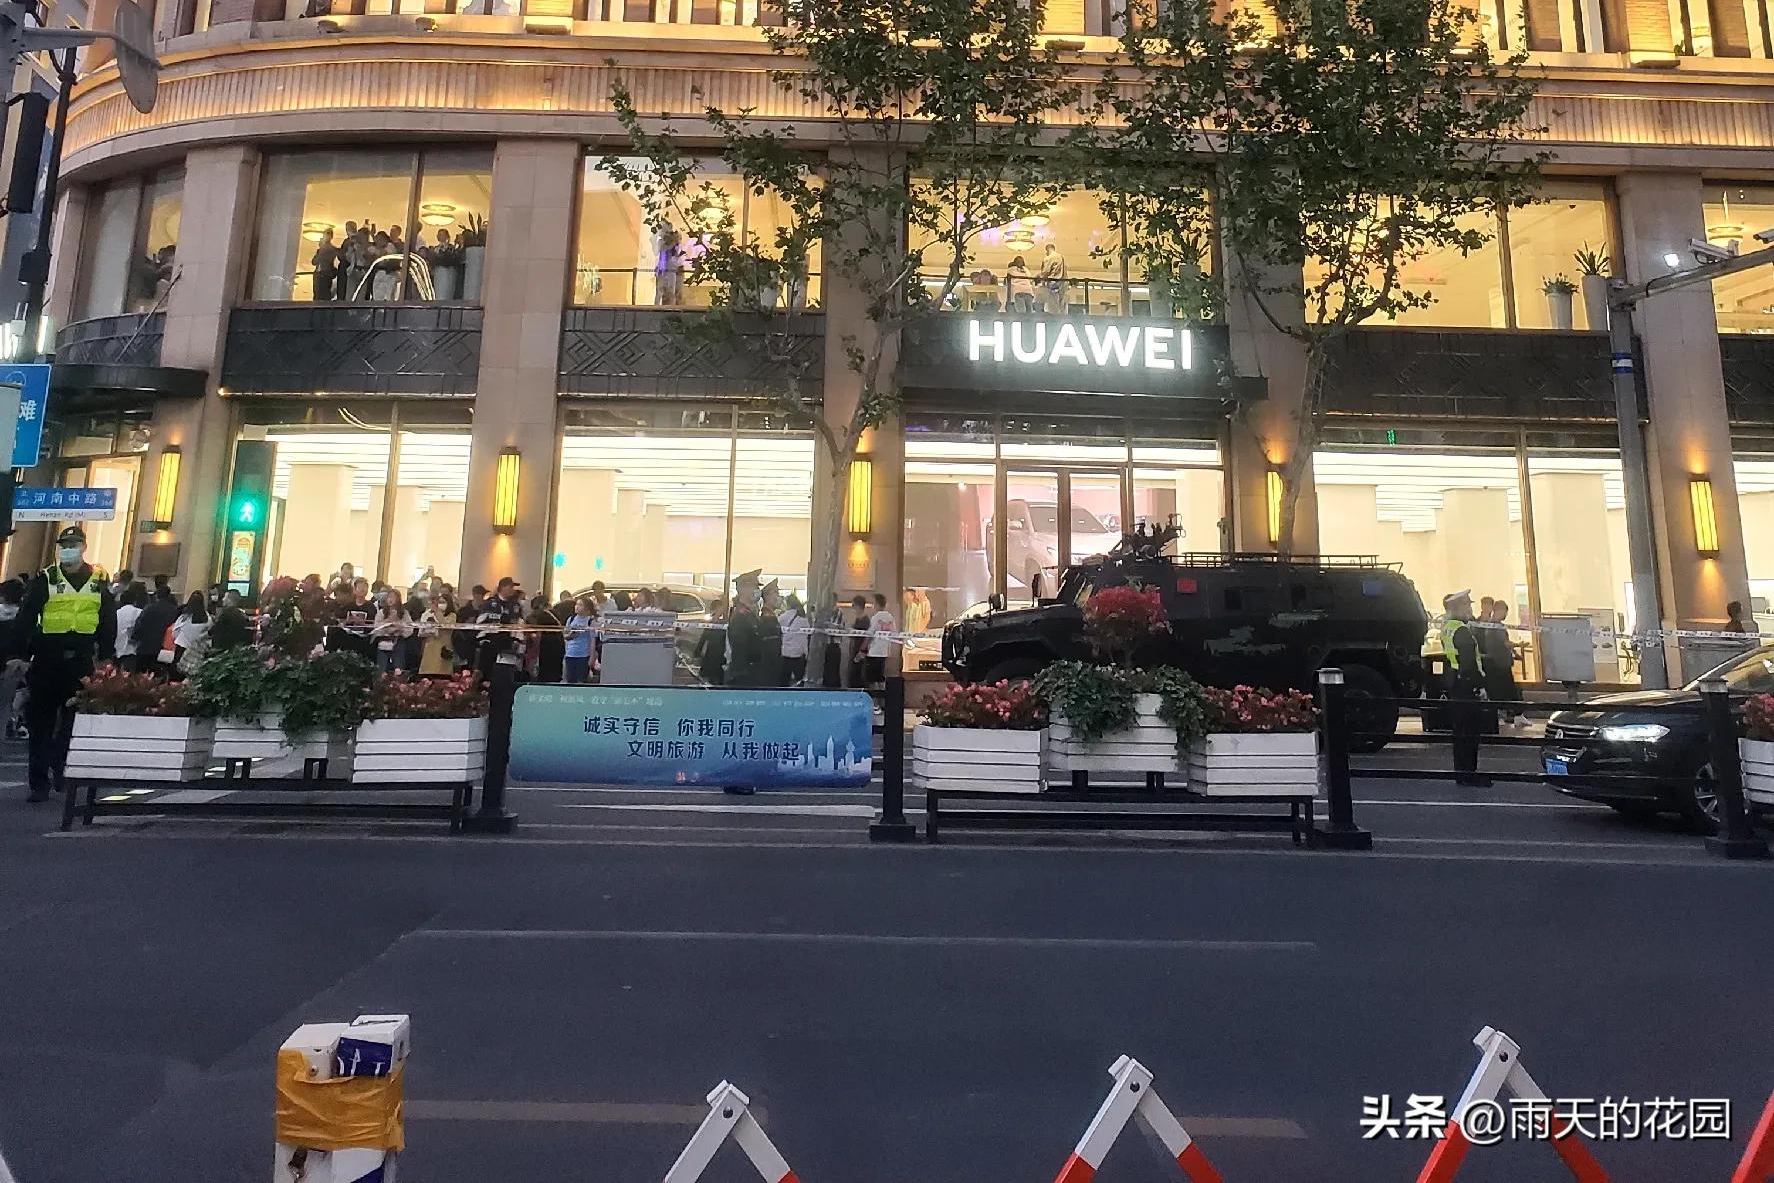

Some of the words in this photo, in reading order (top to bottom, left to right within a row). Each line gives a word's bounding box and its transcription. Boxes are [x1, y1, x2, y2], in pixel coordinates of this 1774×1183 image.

[968, 319, 1193, 370] HUAWEI
[32, 492, 97, 505] 河南中路
[583, 716, 660, 735] 诚实守信
[677, 718, 755, 737] 你我同行
[627, 740, 705, 759] 文明旅游
[721, 742, 800, 760] 从我做起
